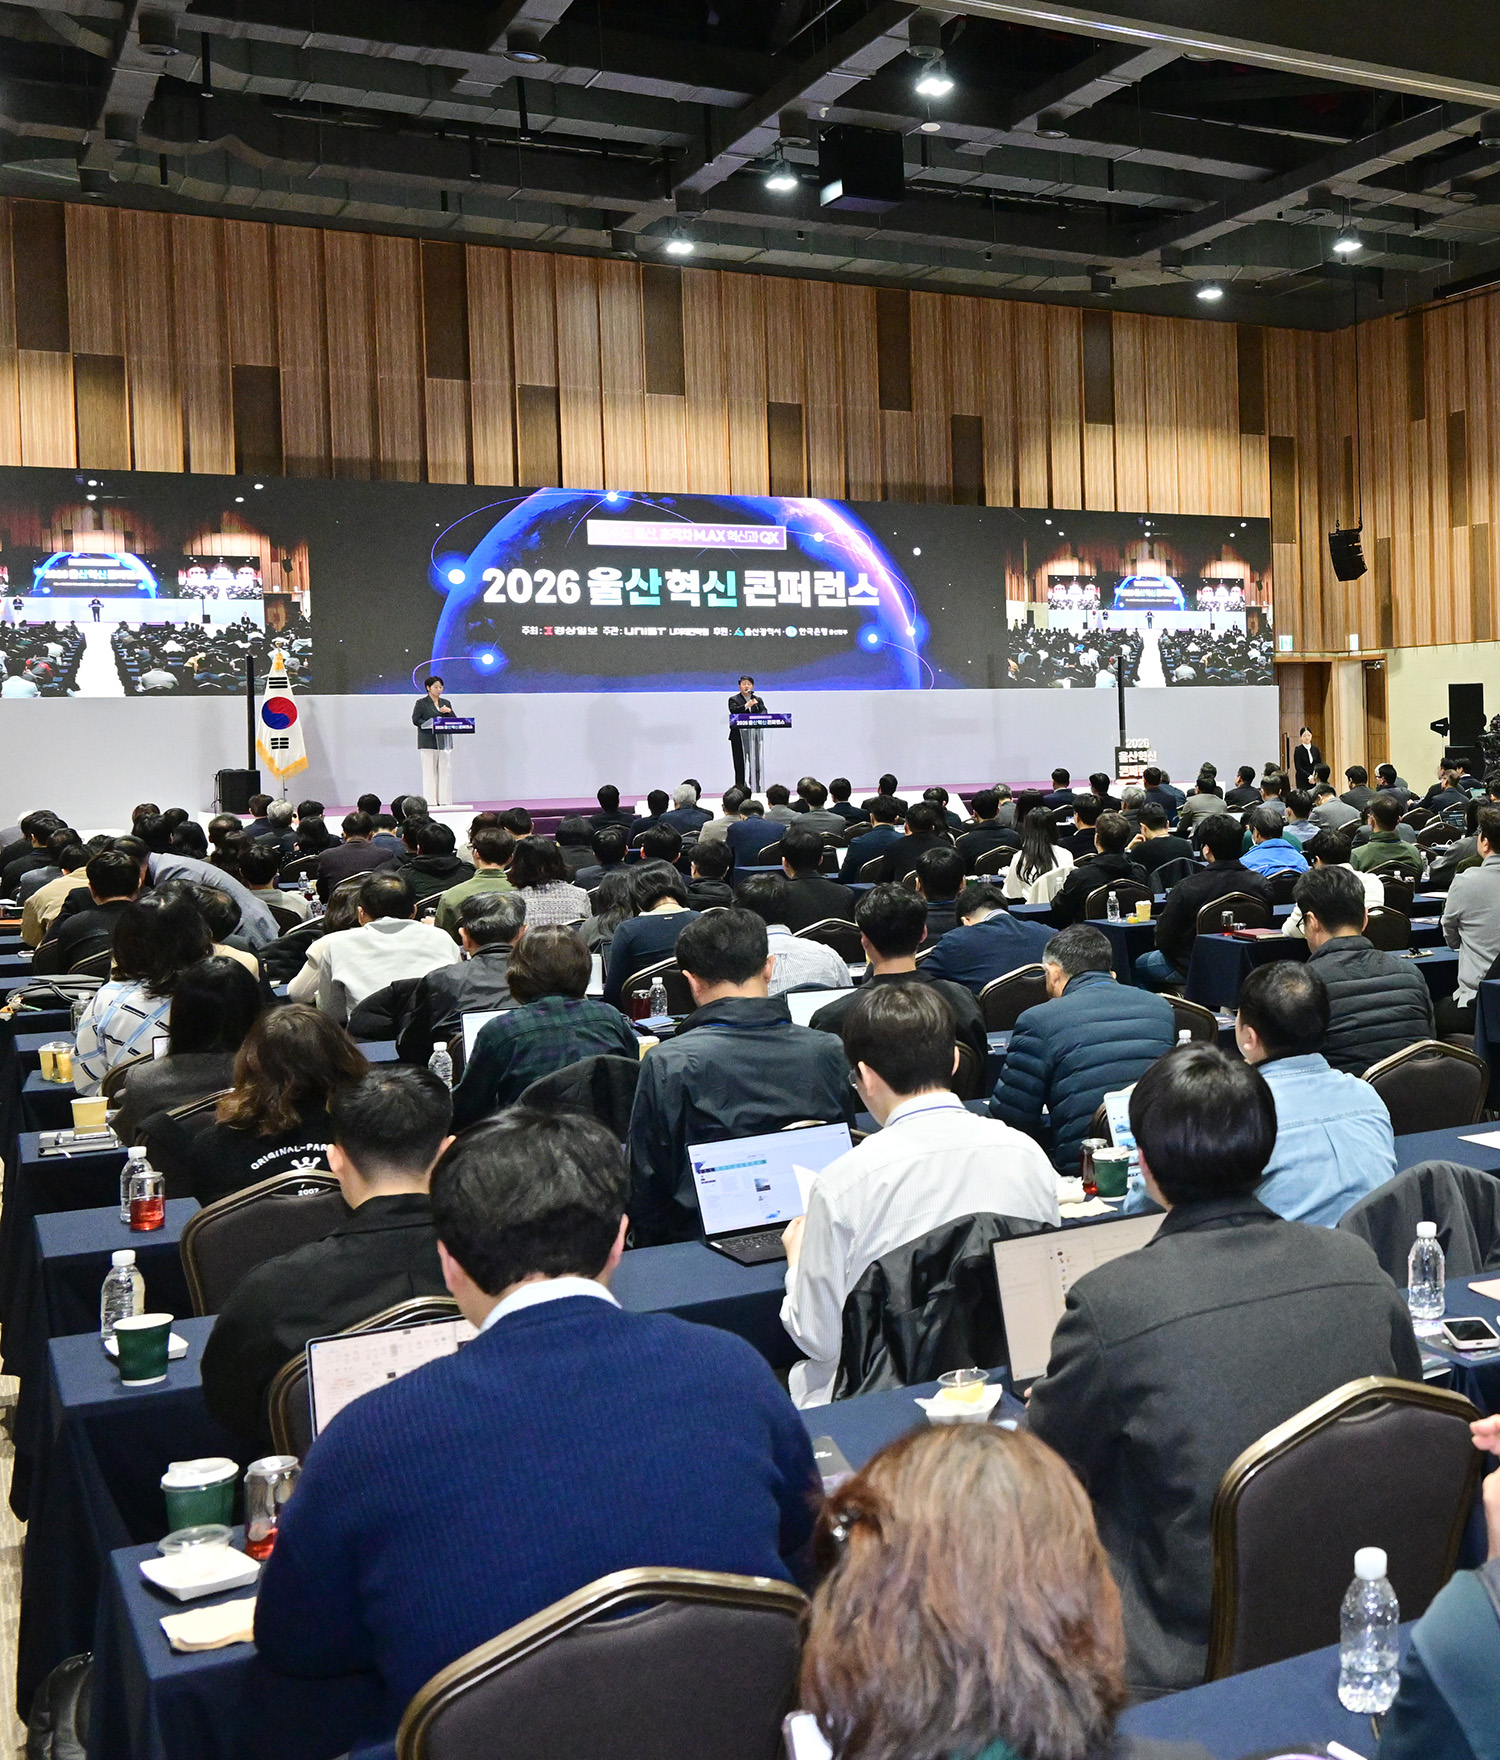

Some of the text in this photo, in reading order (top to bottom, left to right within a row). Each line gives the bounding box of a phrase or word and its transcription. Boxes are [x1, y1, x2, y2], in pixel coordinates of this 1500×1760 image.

[482, 567, 582, 605] 2026
[742, 569, 881, 608] 콘퍼런스
[554, 626, 599, 636] 경상일보
[1125, 738, 1150, 748] 2026
[250, 1143, 328, 1170] ORIGINAL-PAR
[297, 1187, 320, 1197] 2007
